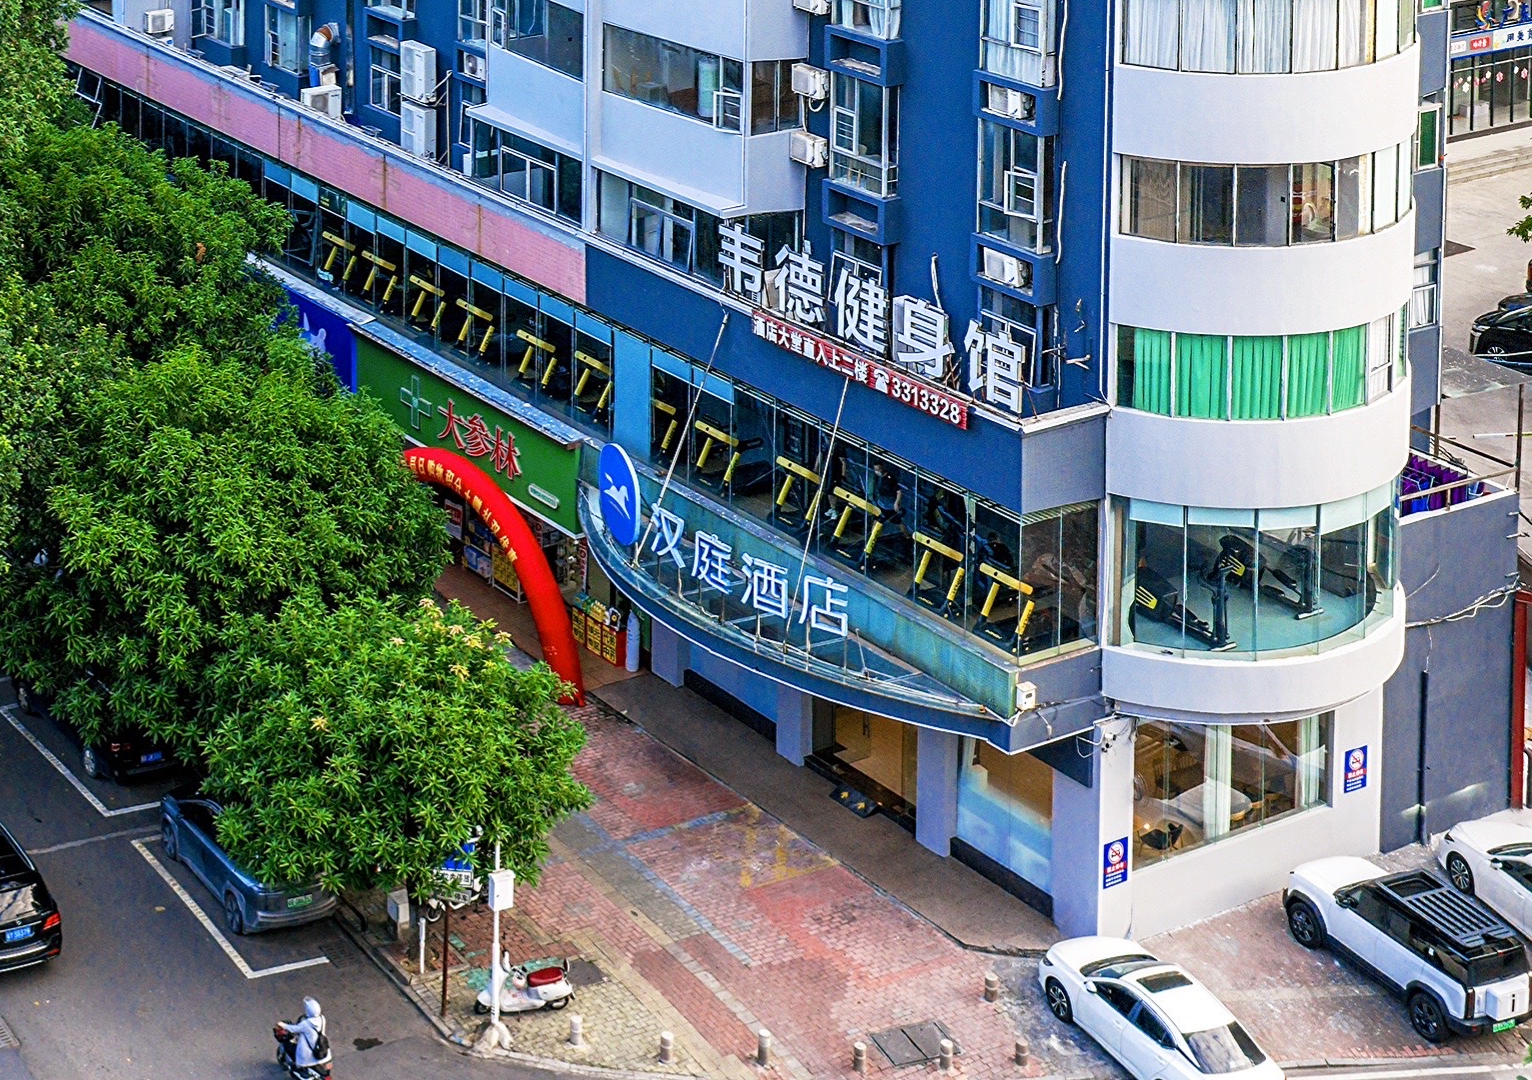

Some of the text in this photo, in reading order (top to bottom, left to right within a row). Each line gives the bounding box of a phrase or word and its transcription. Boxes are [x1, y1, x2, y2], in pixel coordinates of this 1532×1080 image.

[718, 222, 1026, 415] 韦德健身馆
[752, 313, 961, 425] 酒店大堂直入上二楼 3313328
[437, 398, 523, 481] 大参林
[650, 502, 849, 637] 汉庭酒店
